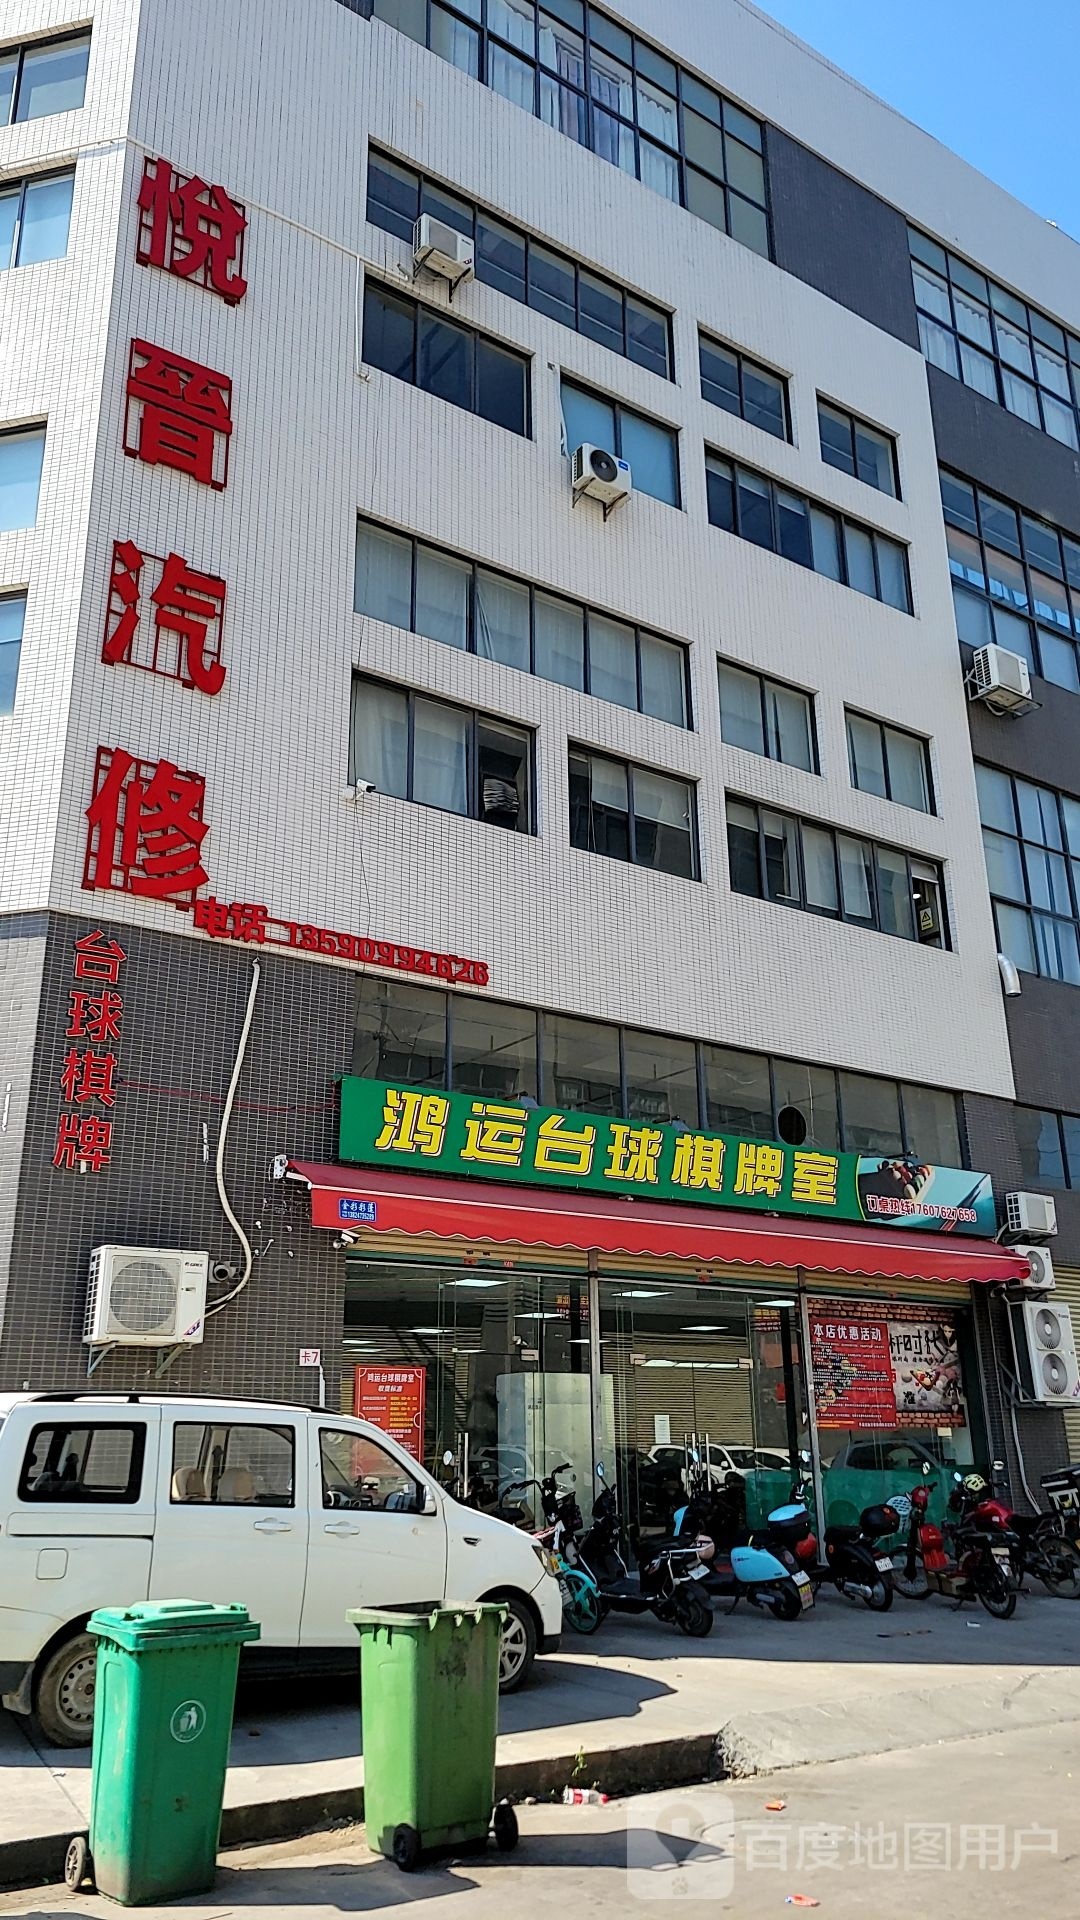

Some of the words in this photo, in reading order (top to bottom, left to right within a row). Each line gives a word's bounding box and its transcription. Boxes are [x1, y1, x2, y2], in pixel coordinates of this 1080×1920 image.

[86, 157, 248, 902] 悦晋汽修
[193, 897, 268, 944] 电话
[286, 921, 490, 987] 13590994626
[52, 929, 127, 1174] 台球棋牌
[374, 1088, 838, 1206] 鸿运台球棋牌室
[300, 1351, 319, 1364] 卡7
[813, 1323, 882, 1342] 本店优惠活动
